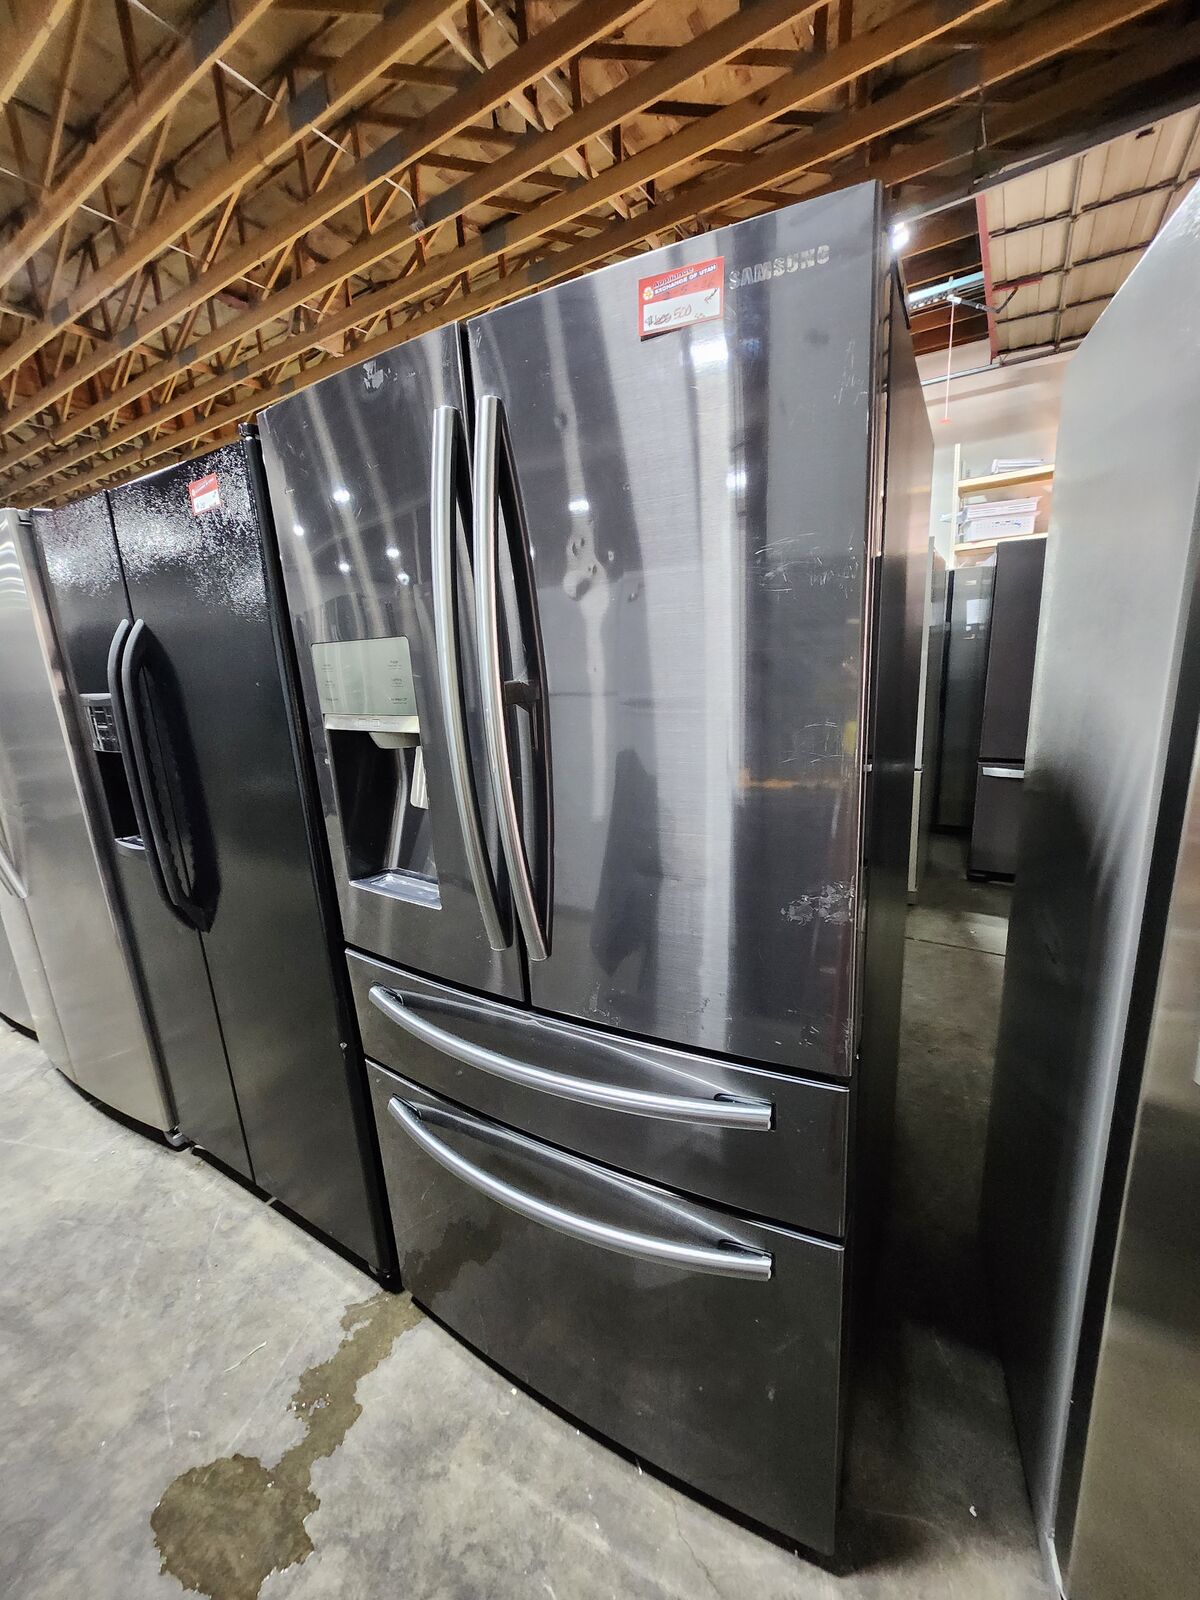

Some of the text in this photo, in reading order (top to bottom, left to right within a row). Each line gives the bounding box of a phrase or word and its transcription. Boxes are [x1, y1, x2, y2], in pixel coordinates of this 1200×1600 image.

[688, 271, 699, 281] OF
[698, 264, 717, 276] UTAH
[729, 245, 830, 290] SAMSUNG
